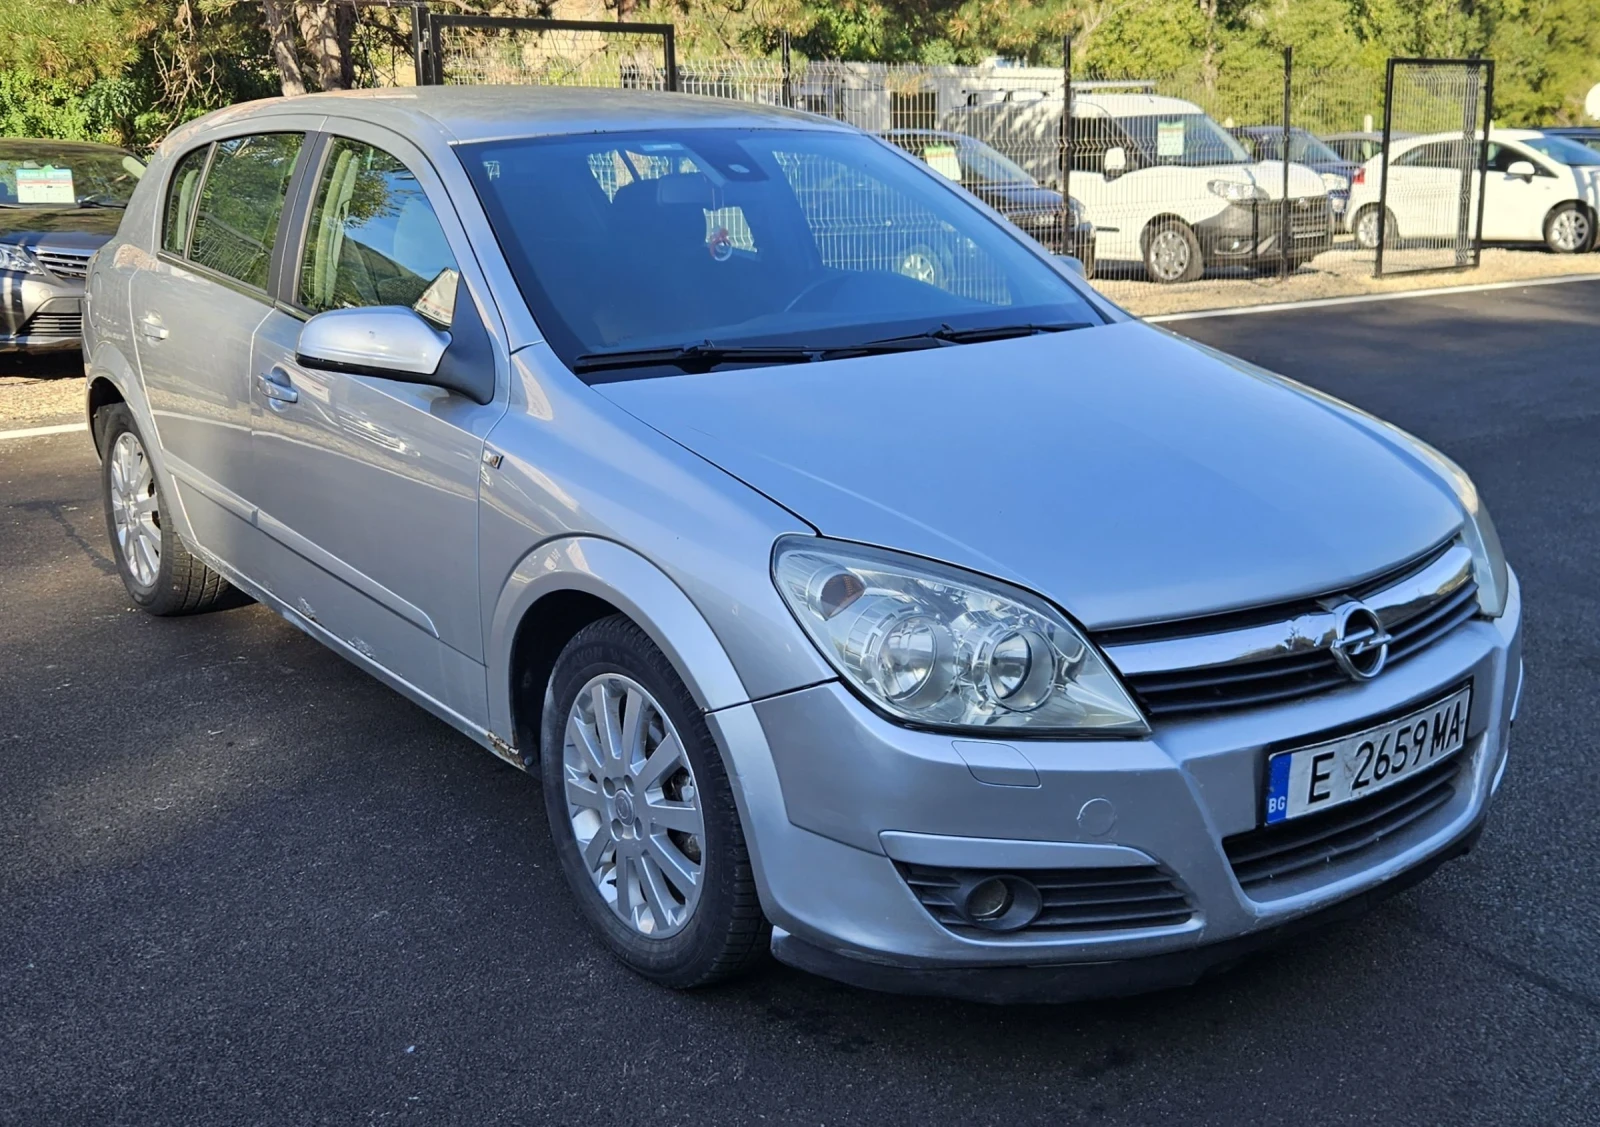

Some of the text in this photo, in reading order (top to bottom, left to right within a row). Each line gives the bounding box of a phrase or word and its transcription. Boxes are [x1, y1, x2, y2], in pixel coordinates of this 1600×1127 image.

[1307, 701, 1461, 804] E 2659 MA
[1268, 796, 1286, 813] BG
